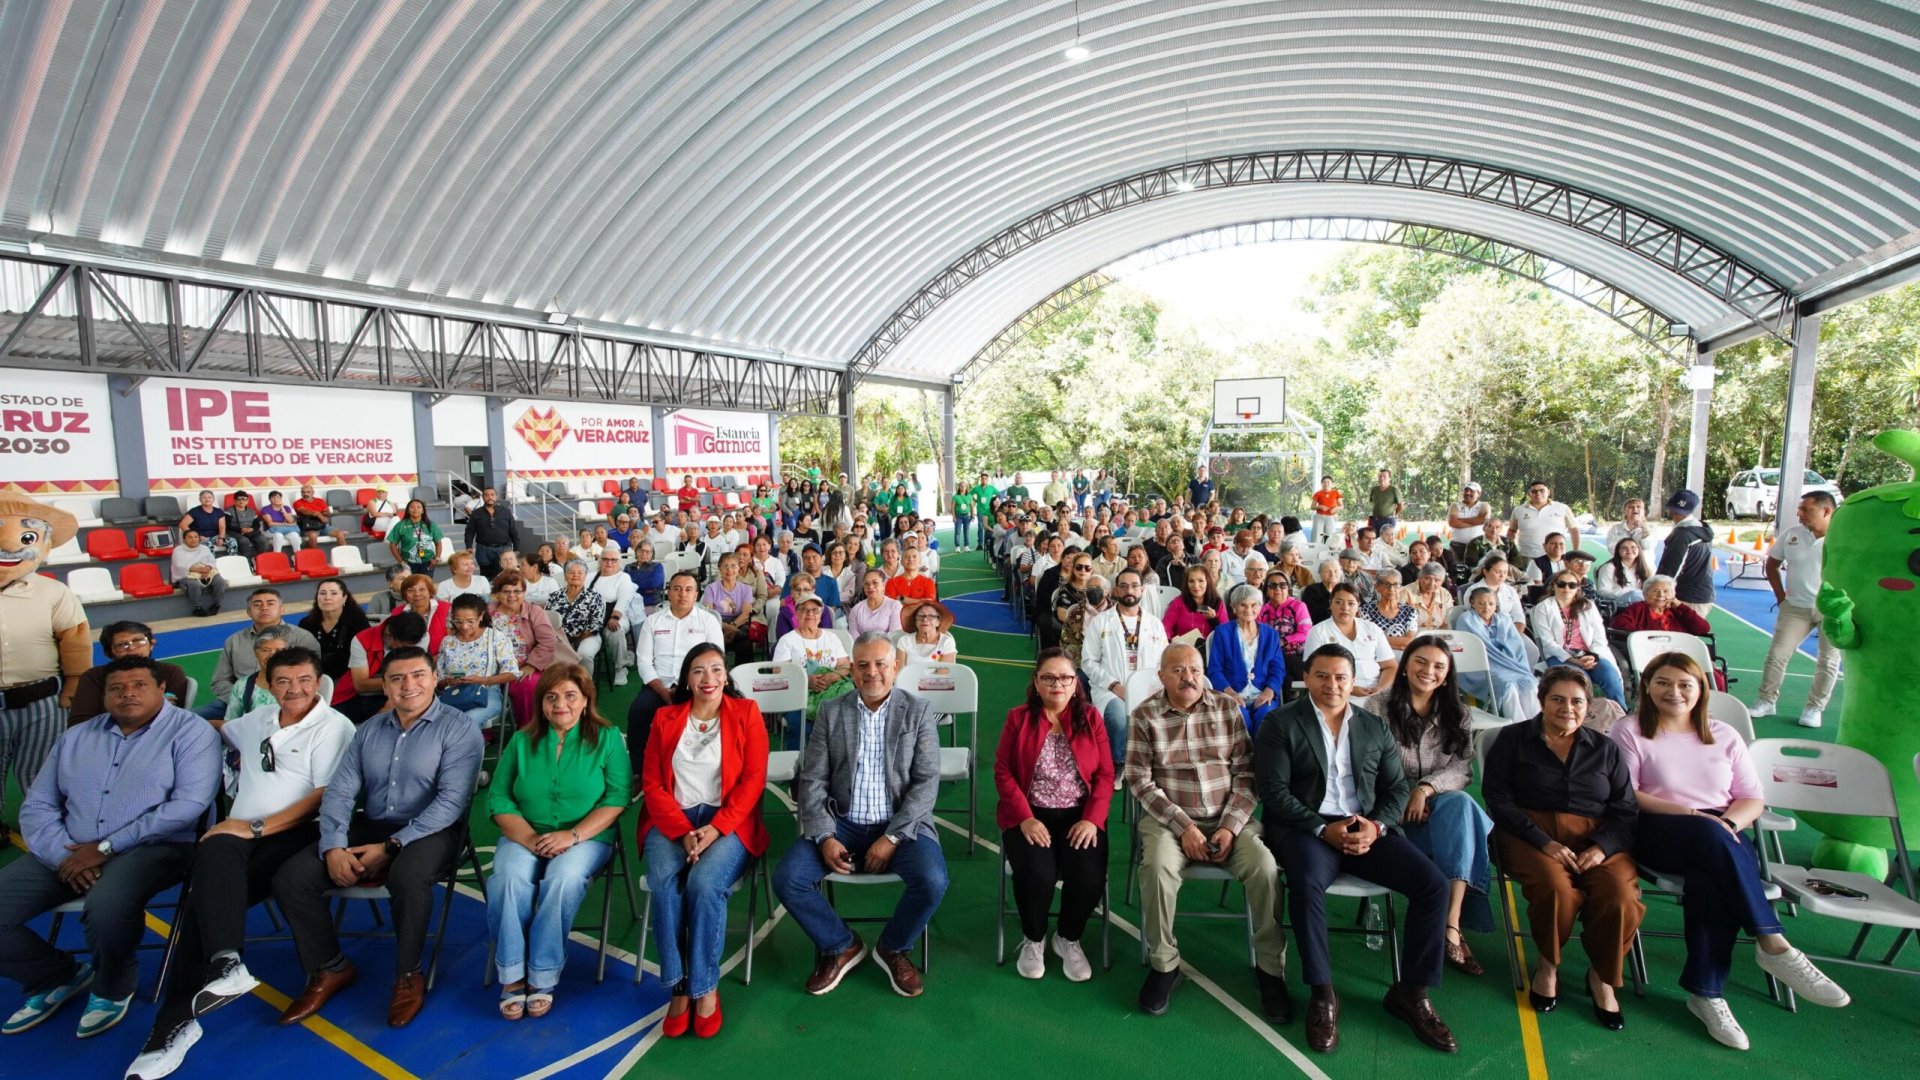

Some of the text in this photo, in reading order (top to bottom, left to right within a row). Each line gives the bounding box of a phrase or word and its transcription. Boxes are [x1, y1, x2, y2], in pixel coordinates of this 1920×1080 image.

[62, 397, 84, 407] DE
[165, 387, 272, 433] IPE
[0, 409, 90, 433] RUZ
[581, 417, 644, 428] POR AMOR A
[573, 429, 649, 443] VERACRUZ
[716, 426, 760, 439] Estancia
[0, 437, 70, 454] 2030
[171, 437, 393, 450] INSTITUTO DE PENSIONES
[703, 436, 761, 453] Garnica
[173, 452, 393, 466] DEL ESTADO DE VERACRUZ
